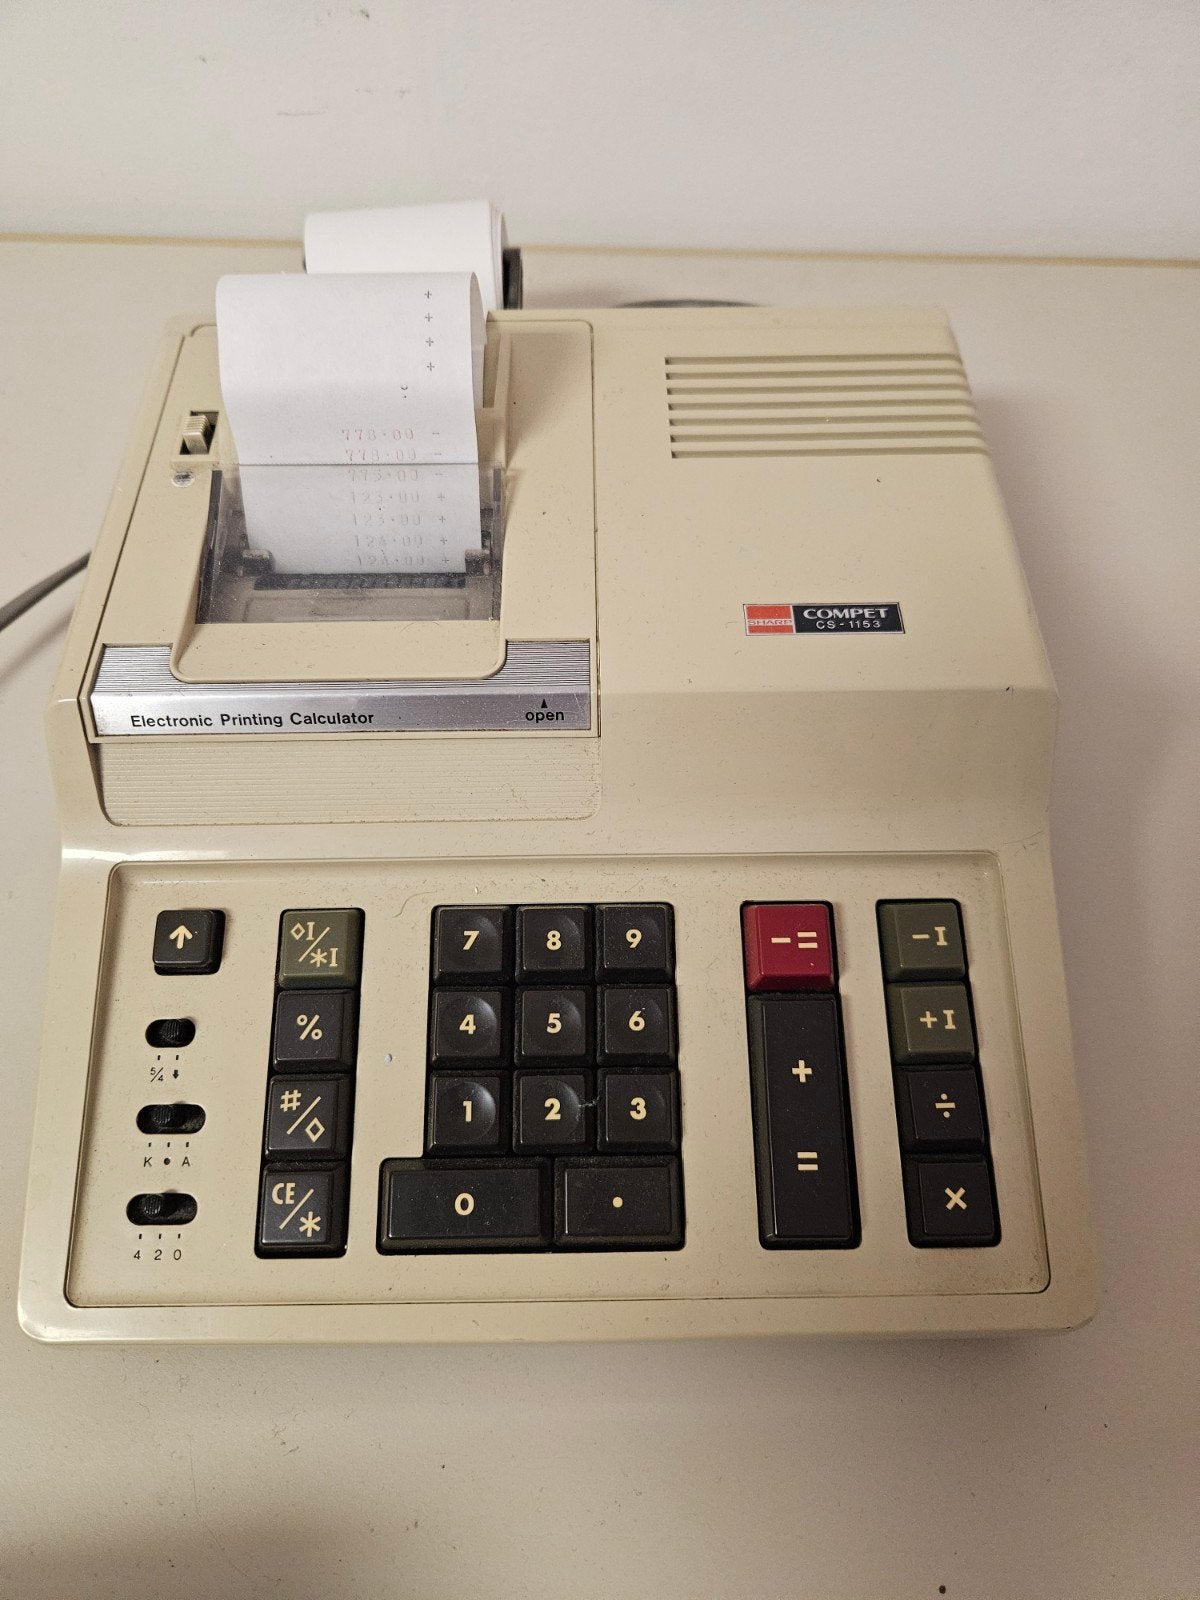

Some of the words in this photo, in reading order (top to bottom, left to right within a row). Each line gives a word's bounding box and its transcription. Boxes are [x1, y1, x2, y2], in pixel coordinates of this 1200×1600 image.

[803, 608, 888, 620] COMPET
[130, 715, 213, 727] Electronic
[220, 713, 283, 727] Printing
[290, 712, 374, 725] Calculator
[525, 711, 565, 723] open
[463, 930, 479, 951] 7
[546, 930, 562, 951] 8
[625, 928, 642, 949] 9
[296, 1014, 323, 1041] %
[459, 1014, 476, 1035] 4
[546, 1012, 562, 1034] 5
[628, 1010, 645, 1032] 6
[462, 1100, 473, 1122] 1
[544, 1097, 562, 1121] 2
[629, 1096, 647, 1121] 3
[143, 1157, 153, 1168] K
[181, 1156, 191, 1168] A
[454, 1192, 475, 1216] 0
[133, 1249, 142, 1261] 4
[153, 1249, 163, 1261] 2
